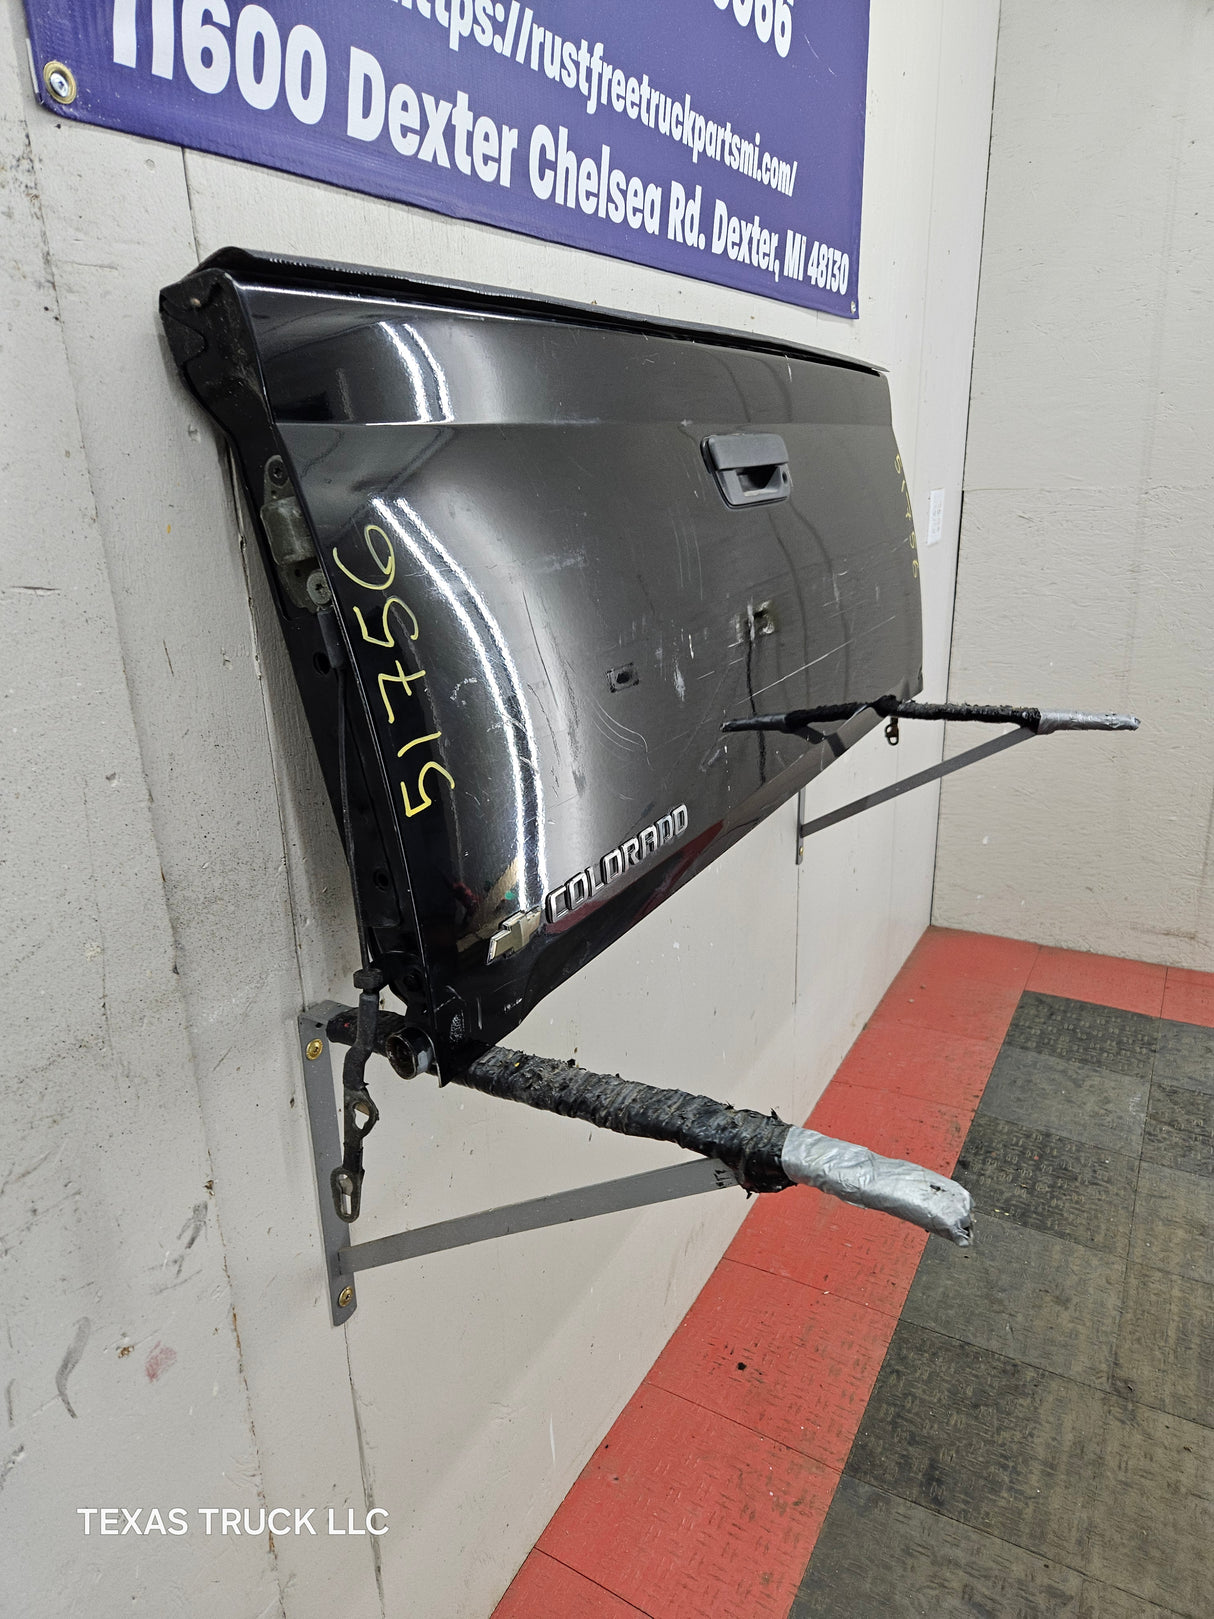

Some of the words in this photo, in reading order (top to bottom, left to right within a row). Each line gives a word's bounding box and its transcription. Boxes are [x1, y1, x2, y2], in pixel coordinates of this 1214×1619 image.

[112, 0, 327, 125] 11600
[346, 46, 518, 188] Dexter
[529, 124, 662, 235] Chelsea
[667, 180, 706, 250] Rd.
[711, 199, 779, 282] Dexter,
[784, 229, 806, 281] MI
[807, 241, 849, 295] 48130
[332, 524, 455, 818] 51756
[545, 804, 689, 924] COLORADO
